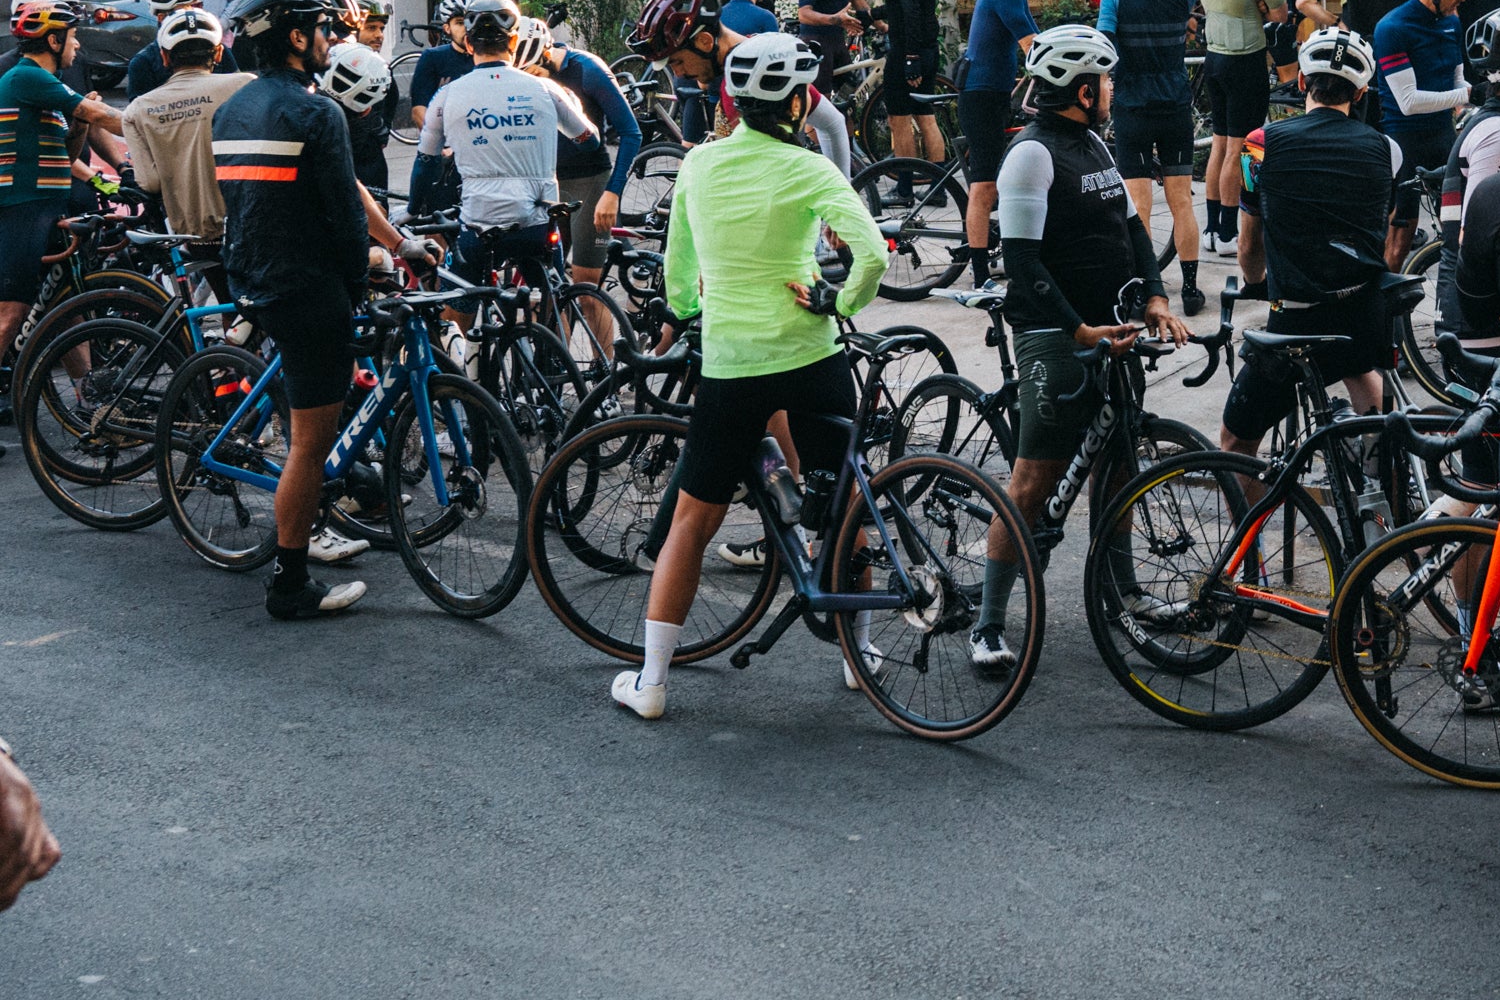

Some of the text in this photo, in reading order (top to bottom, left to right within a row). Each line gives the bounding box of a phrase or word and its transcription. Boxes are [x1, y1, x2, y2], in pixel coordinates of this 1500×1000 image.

[1335, 43, 1344, 62] POC
[147, 96, 213, 117] PAS NORMAL
[158, 108, 202, 124] STUDIOS
[467, 113, 536, 131] MONEX
[324, 367, 397, 468] TREK
